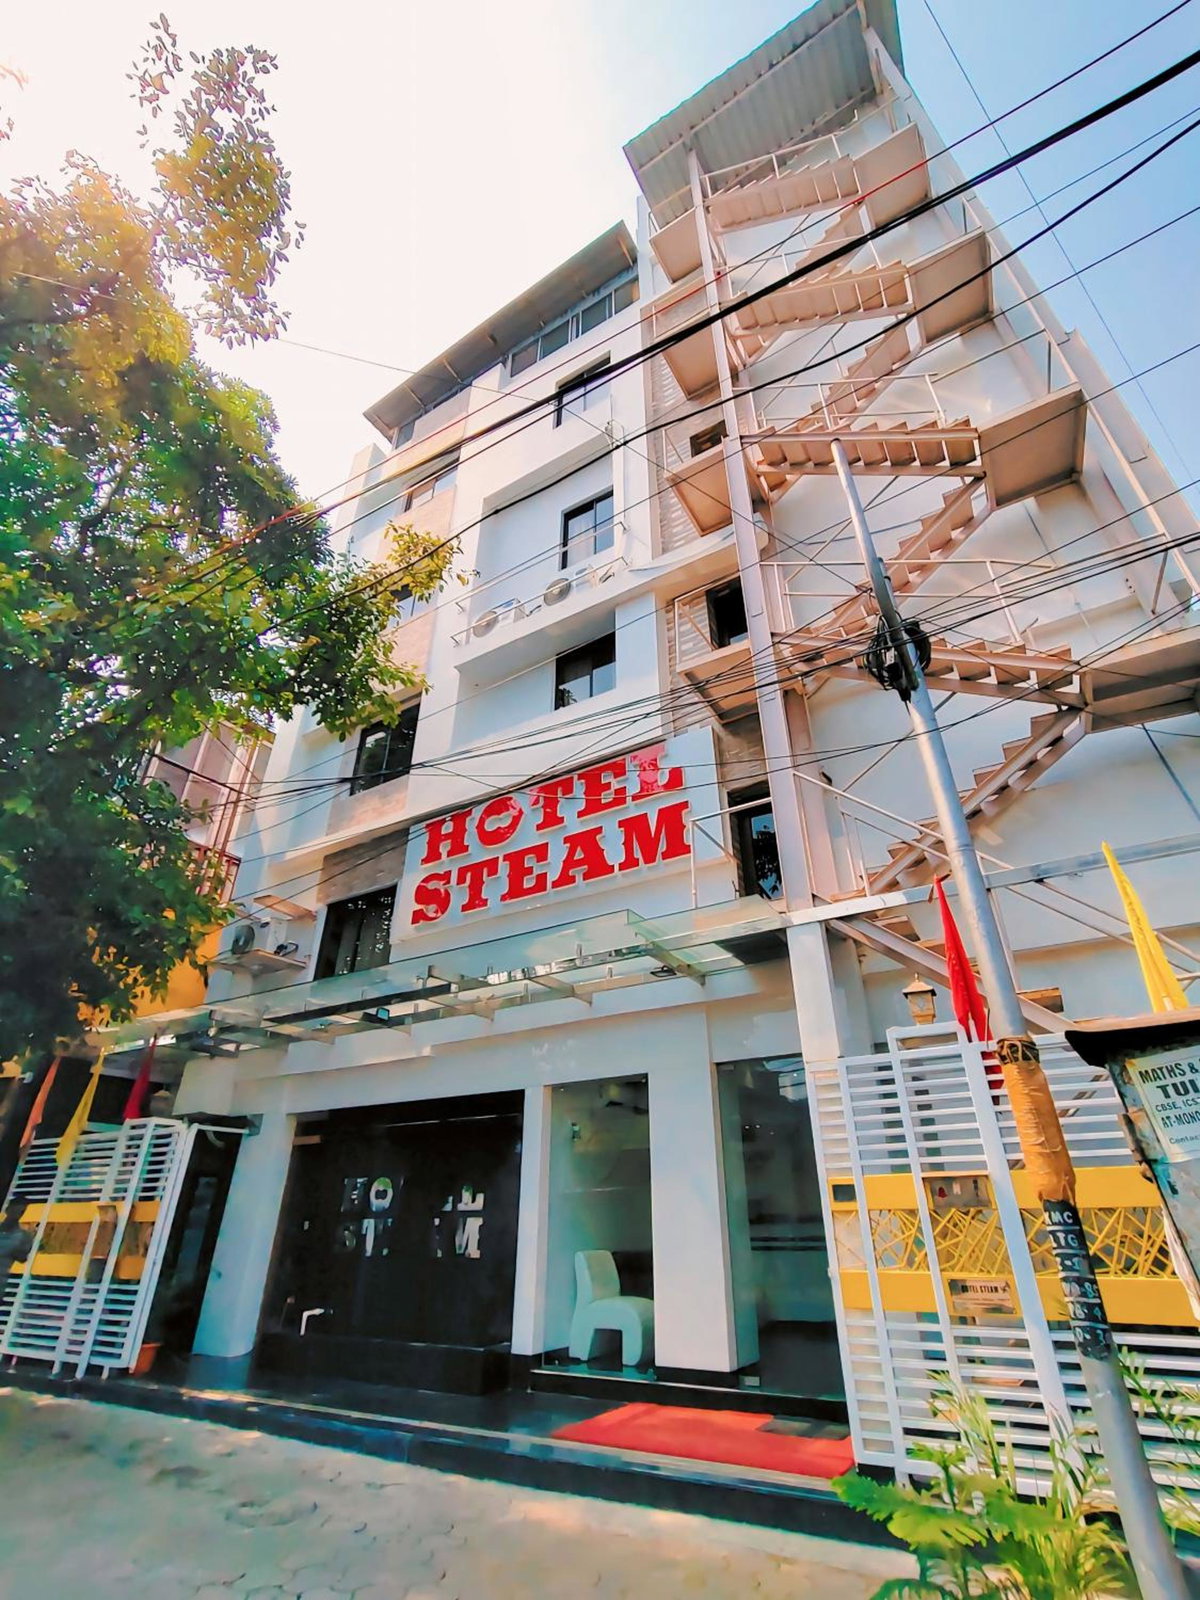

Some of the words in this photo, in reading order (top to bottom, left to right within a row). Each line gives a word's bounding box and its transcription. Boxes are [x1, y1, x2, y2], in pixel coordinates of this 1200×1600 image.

[411, 801, 692, 926] STEAM
[420, 742, 684, 866] HOTEL
[1138, 1062, 1187, 1084] MATHS
[1187, 1062, 1199, 1074] &
